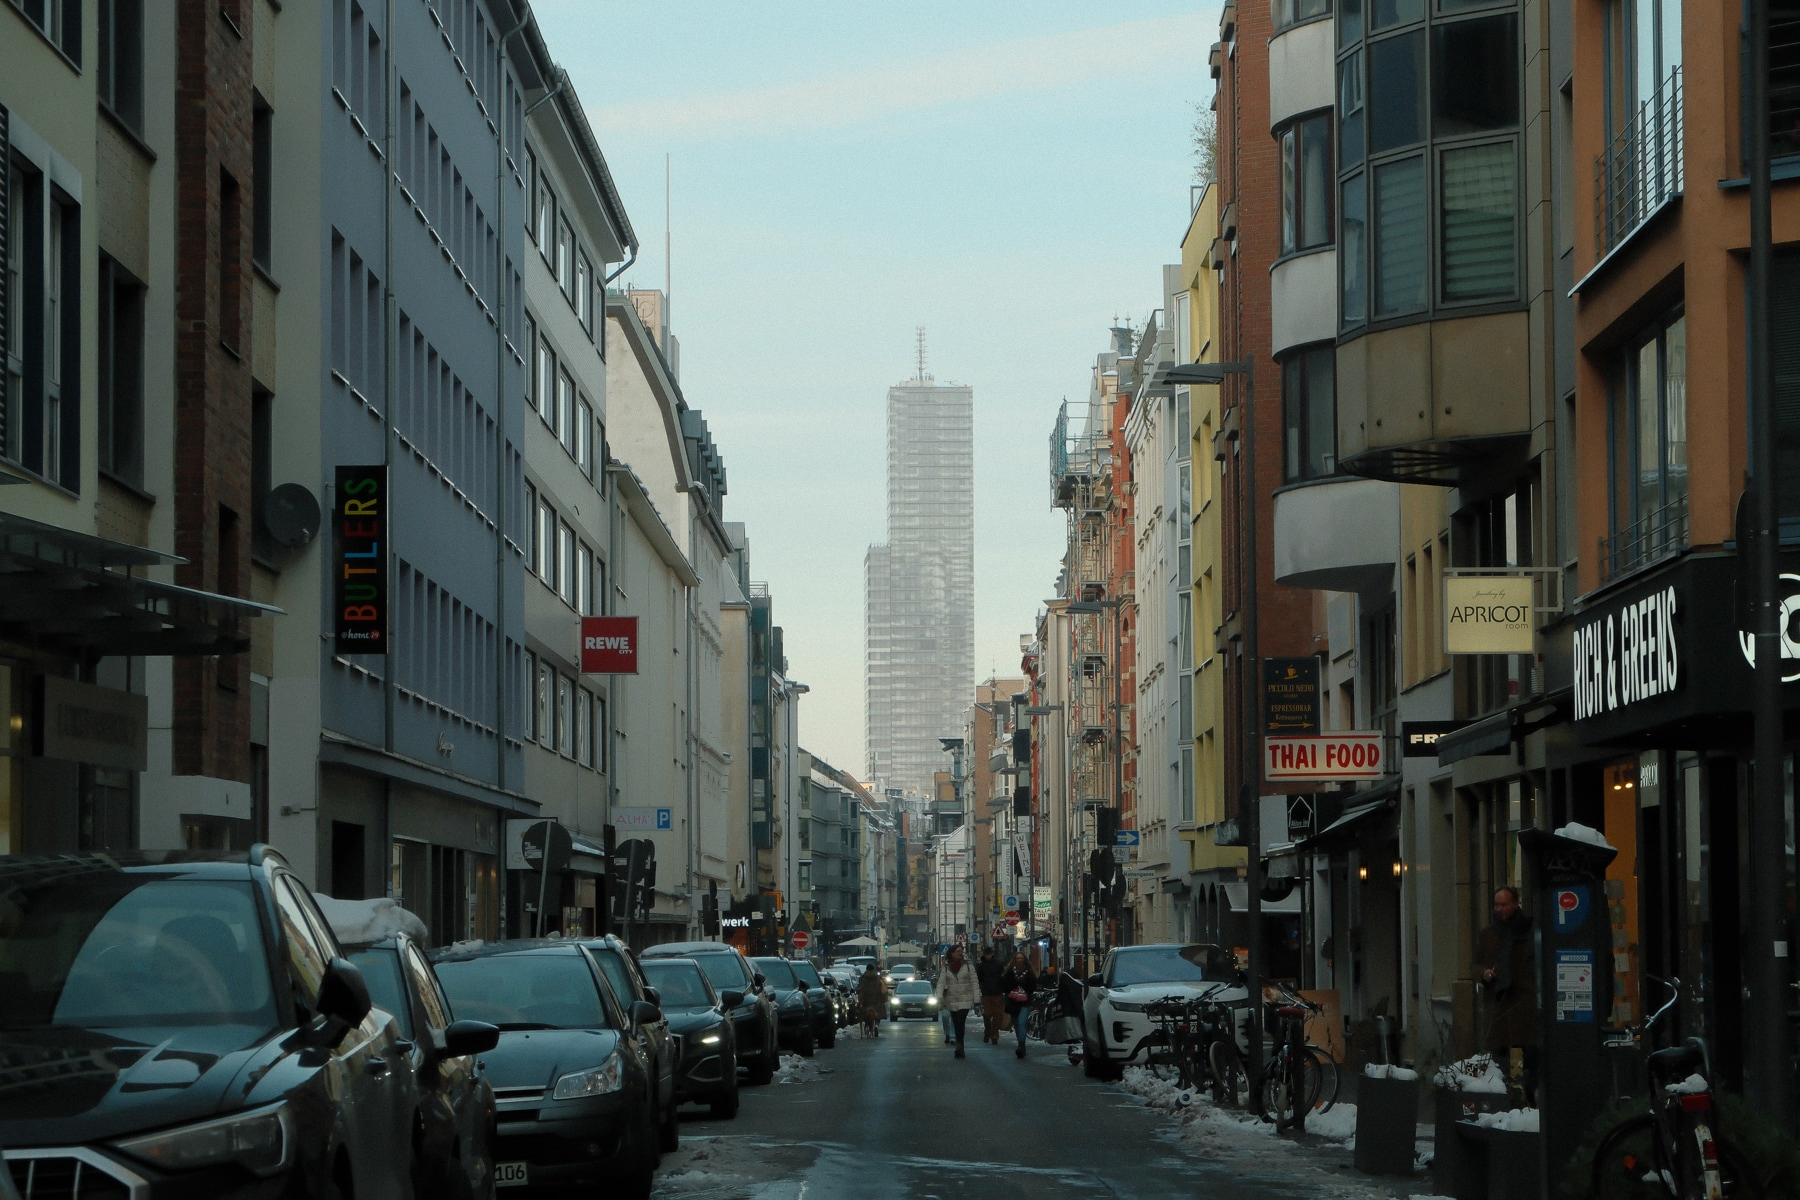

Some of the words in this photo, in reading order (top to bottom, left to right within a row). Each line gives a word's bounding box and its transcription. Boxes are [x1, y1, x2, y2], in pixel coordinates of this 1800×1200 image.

[344, 478, 378, 621] BUTLERS
[1450, 605, 1529, 623] APRICOT
[585, 636, 629, 650] REWE
[1573, 620, 1603, 722] RICH
[1606, 613, 1618, 711] &
[1621, 585, 1678, 706] GREENS
[1271, 704, 1312, 712] ESPRESSOBAR
[1409, 733, 1449, 745] FR
[1269, 744, 1317, 770] THAI
[1326, 743, 1380, 769] FOOD
[659, 811, 669, 826] P
[721, 916, 749, 928] werk
[496, 1165, 525, 1181] 106
